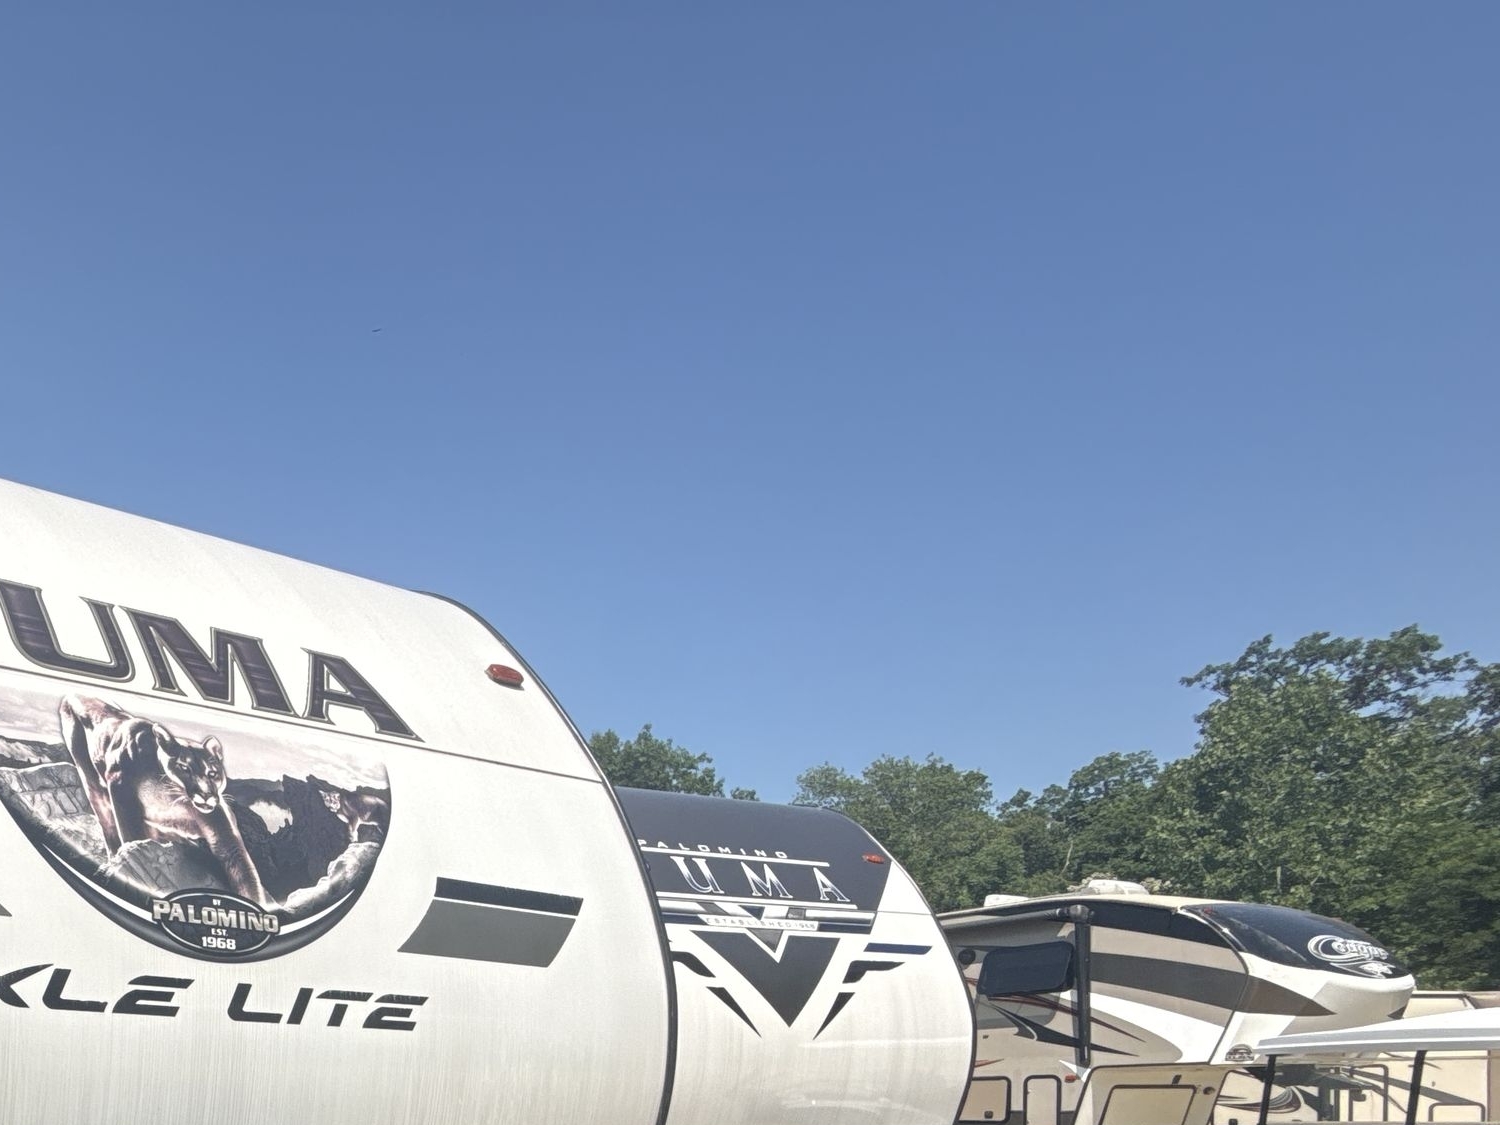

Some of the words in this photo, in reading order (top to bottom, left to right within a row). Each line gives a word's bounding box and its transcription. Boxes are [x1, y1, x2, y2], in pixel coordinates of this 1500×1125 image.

[637, 839, 788, 859] PALOMINO
[152, 899, 279, 933] PALOMINO
[201, 936, 236, 950] 1968
[227, 983, 429, 1031] LITE
